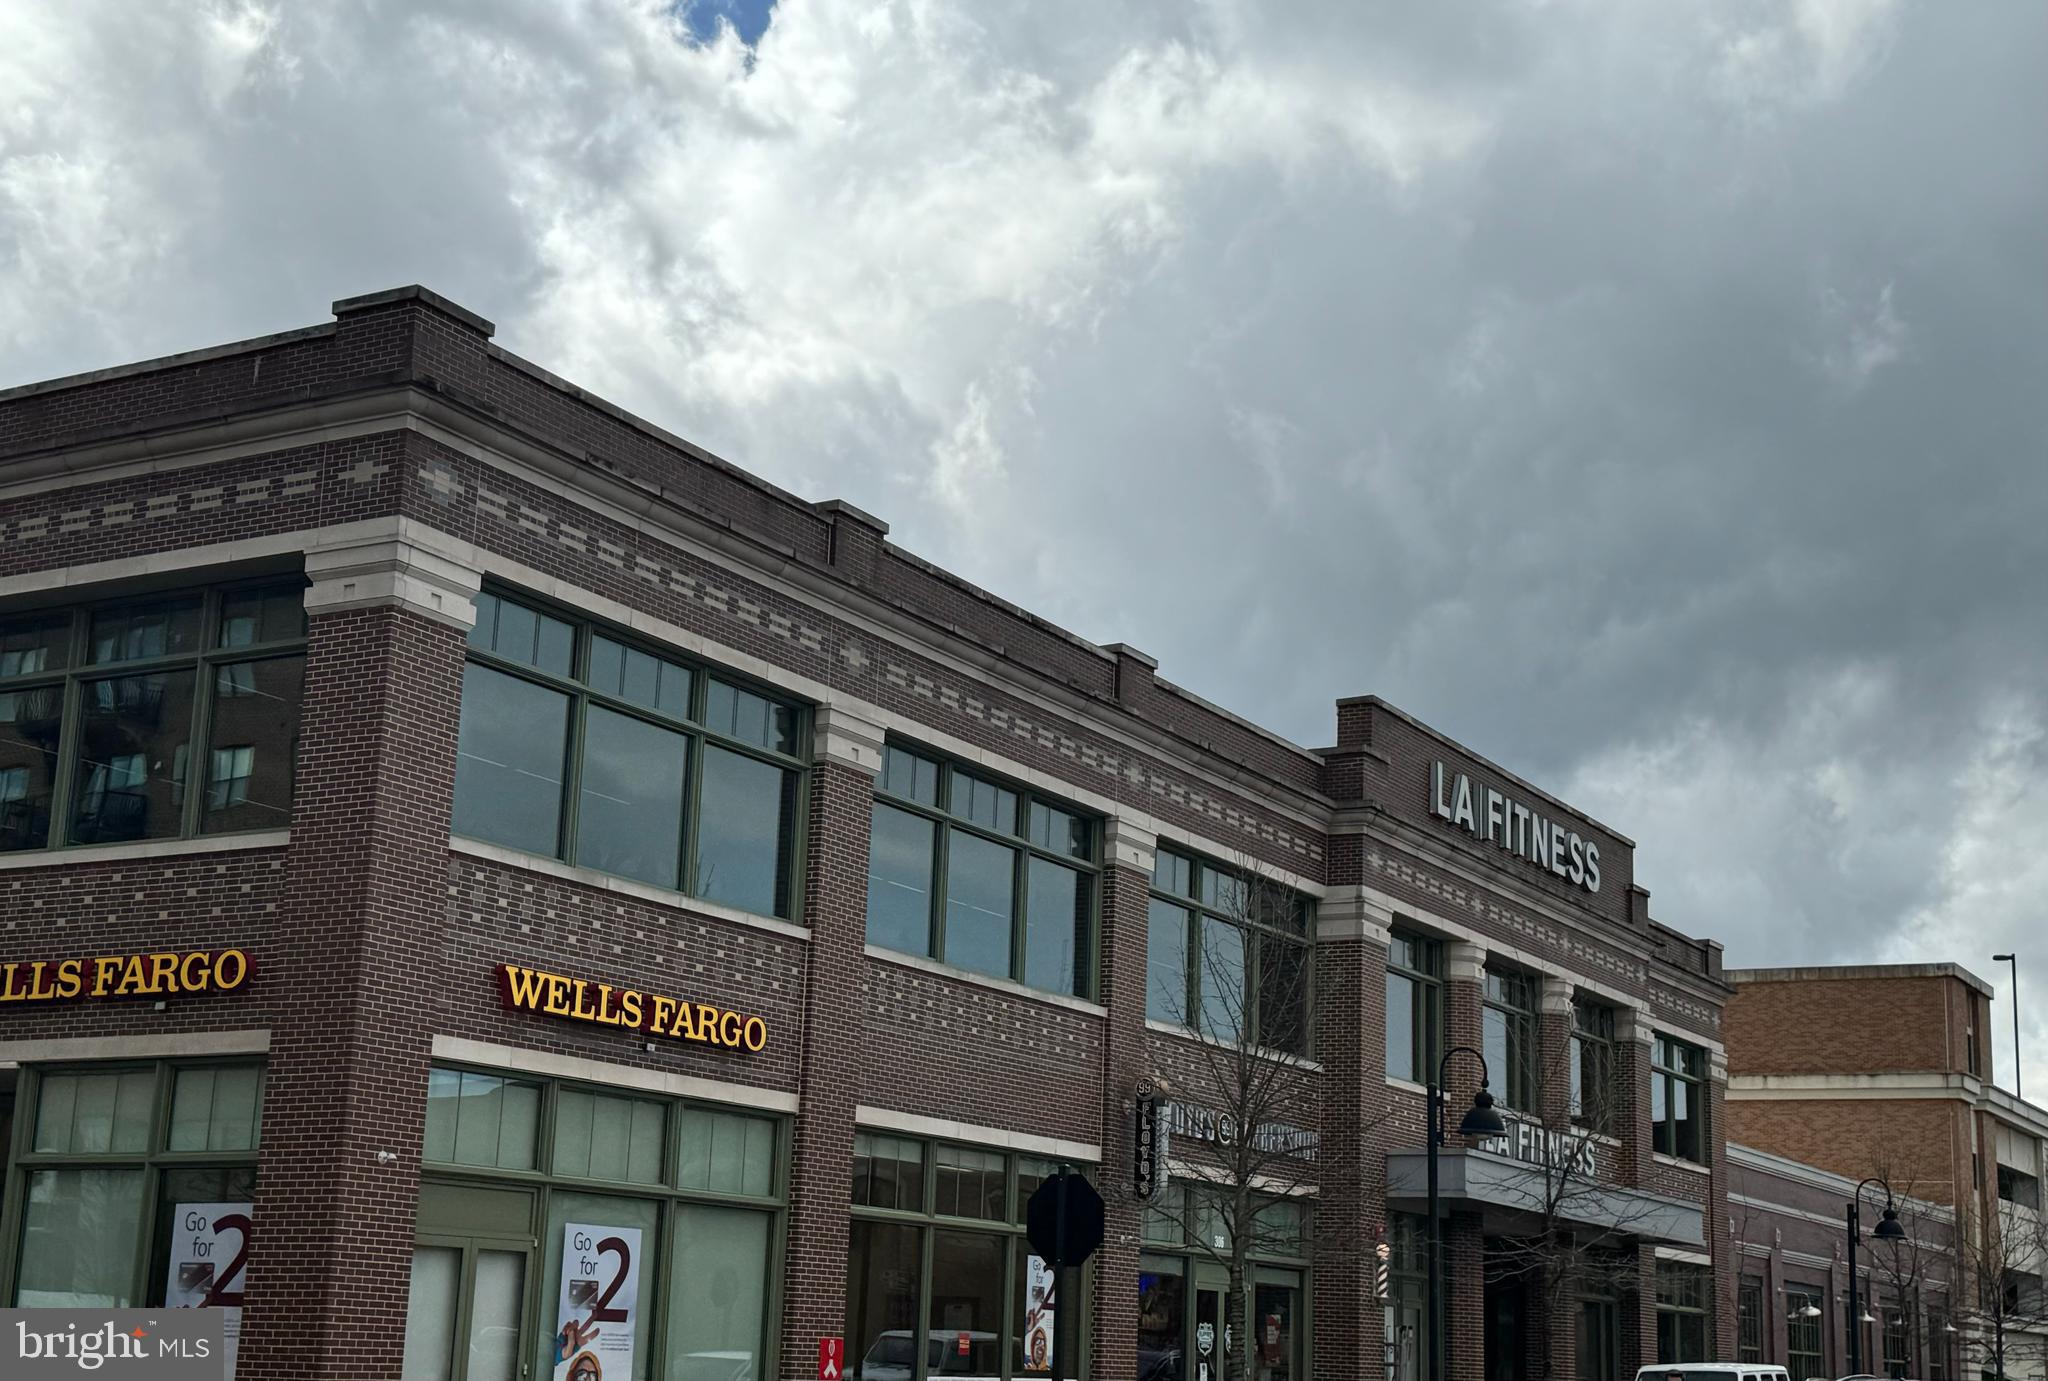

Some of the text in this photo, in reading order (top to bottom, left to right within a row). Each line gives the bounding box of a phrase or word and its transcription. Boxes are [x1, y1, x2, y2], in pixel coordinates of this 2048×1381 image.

[1431, 761, 1601, 893] LA FITNESS
[0, 949, 248, 1001] LLS FARGO
[506, 965, 767, 1051] WELLS FARGO
[1138, 1081, 1151, 1094] 99
[1518, 1121, 1596, 1177] FITNESS
[185, 1211, 207, 1232] Go
[192, 1236, 214, 1257] for
[573, 1231, 592, 1251] Go
[206, 1213, 252, 1307] 2
[580, 1255, 599, 1276] for
[1032, 1259, 1042, 1271] Go
[592, 1236, 631, 1323] 2
